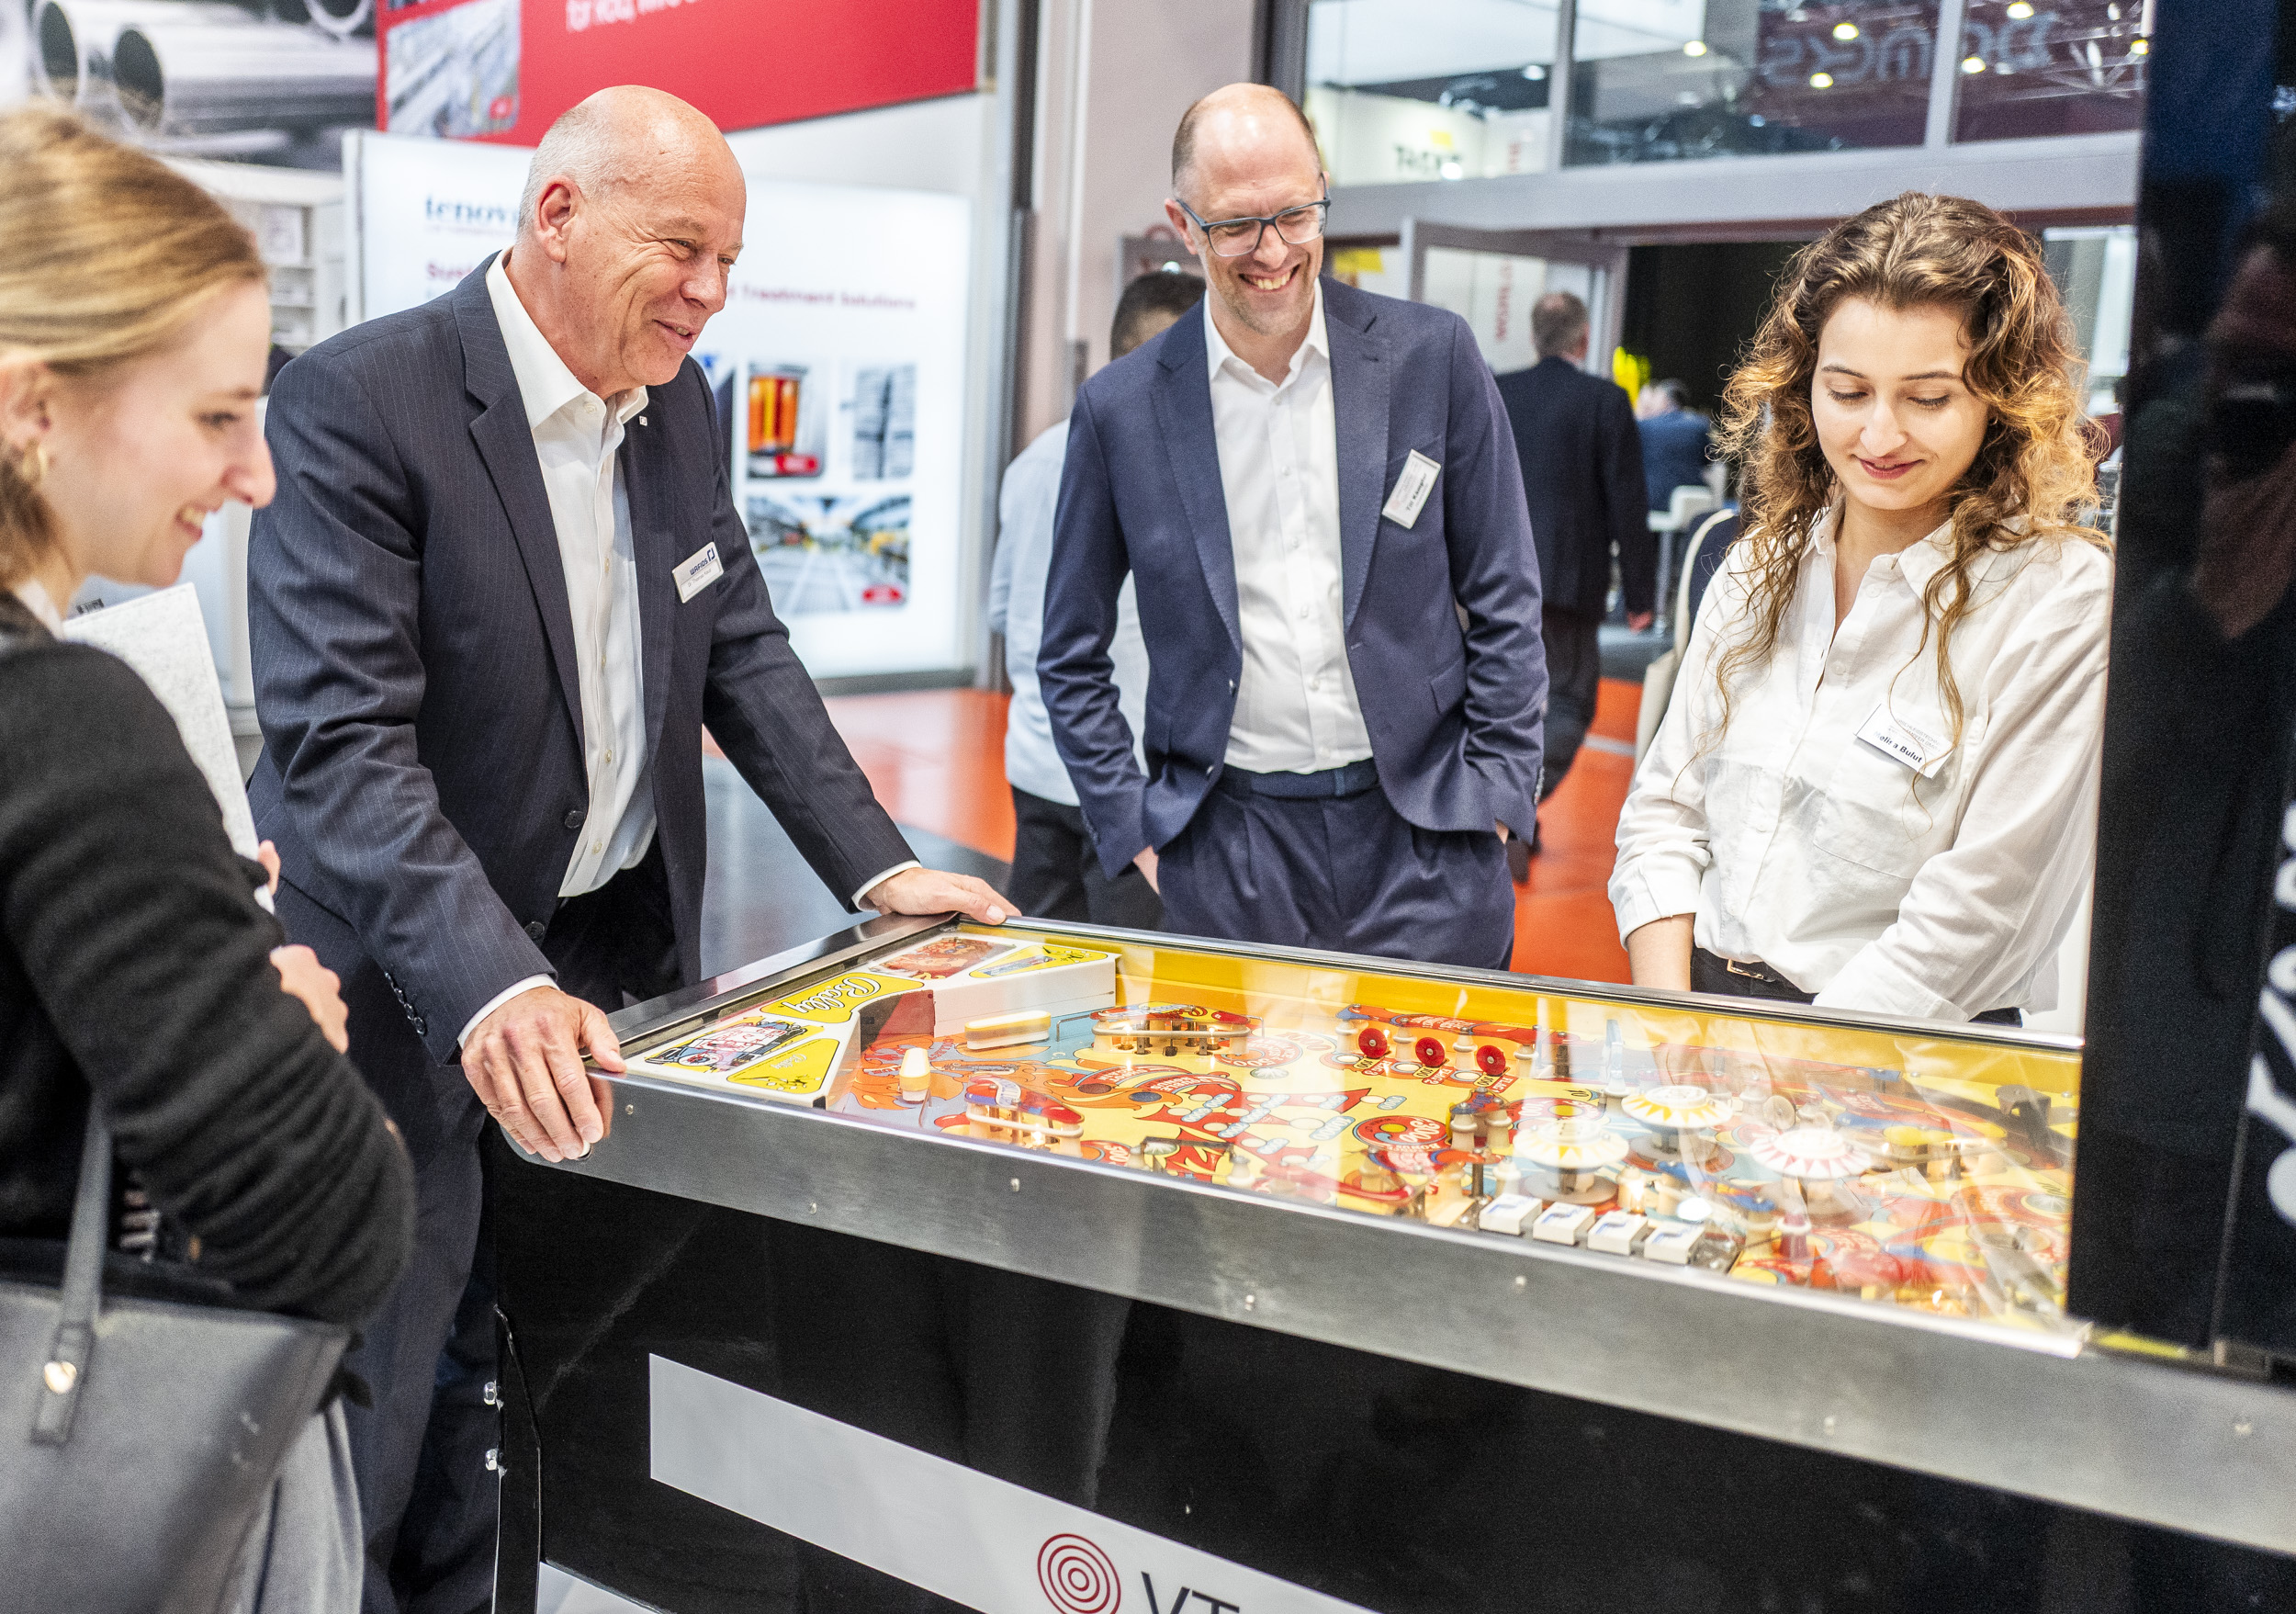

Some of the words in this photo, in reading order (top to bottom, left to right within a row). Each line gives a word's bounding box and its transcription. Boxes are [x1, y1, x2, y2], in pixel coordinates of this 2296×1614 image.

[690, 559, 708, 575] WAFIOS
[1899, 745, 1923, 763] Bulut
[783, 976, 881, 1014] Bally
[771, 1053, 806, 1069] Bally
[1356, 1059, 1374, 1068] 100
[1416, 1067, 1434, 1078] 100
[1164, 1076, 1210, 1092] DOUBLE
[1477, 1077, 1494, 1086] 100
[1496, 1076, 1514, 1089] FLAG
[1380, 1097, 1402, 1110] 1000
[1399, 1120, 1440, 1143] 3000
